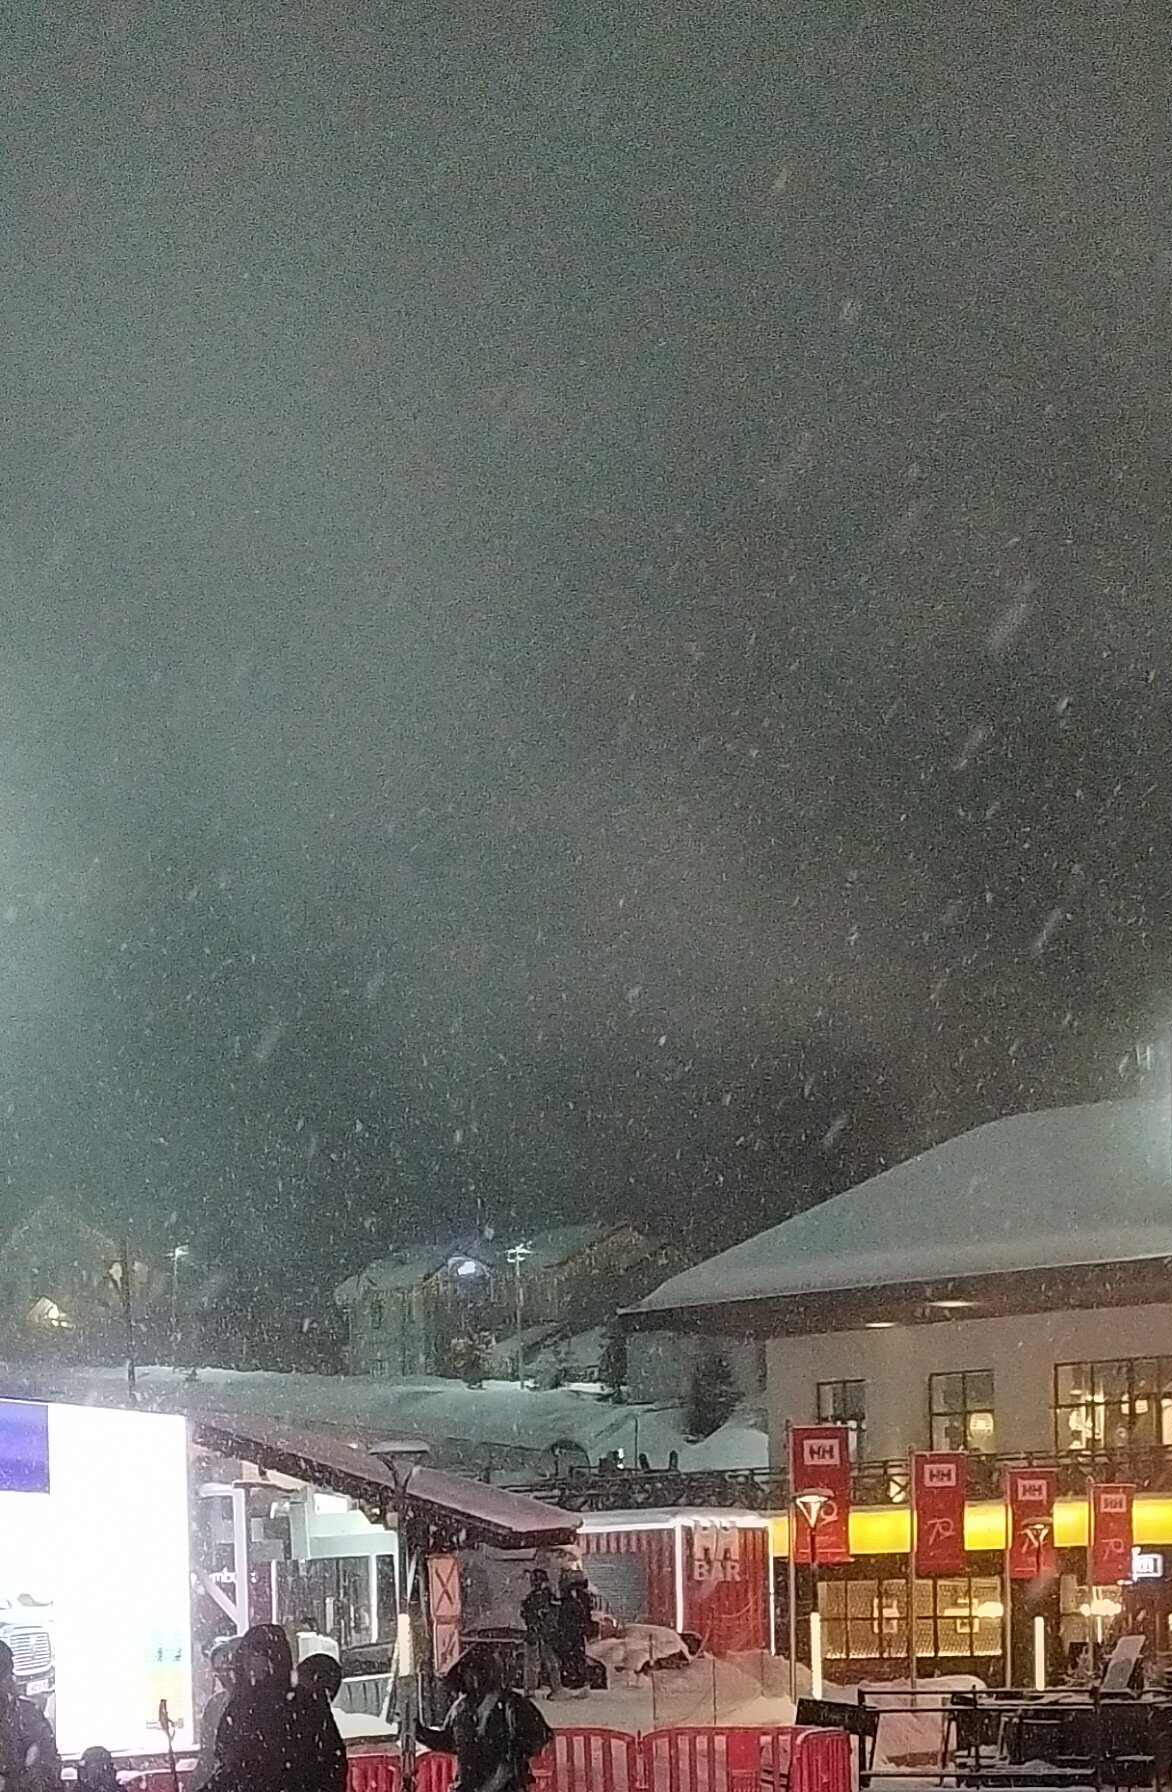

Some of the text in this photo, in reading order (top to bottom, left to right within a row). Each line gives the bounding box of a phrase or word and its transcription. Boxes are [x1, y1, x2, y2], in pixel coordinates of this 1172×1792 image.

[809, 1444, 834, 1461] HH
[929, 1469, 951, 1483] HH
[693, 1560, 741, 1581] BAR
